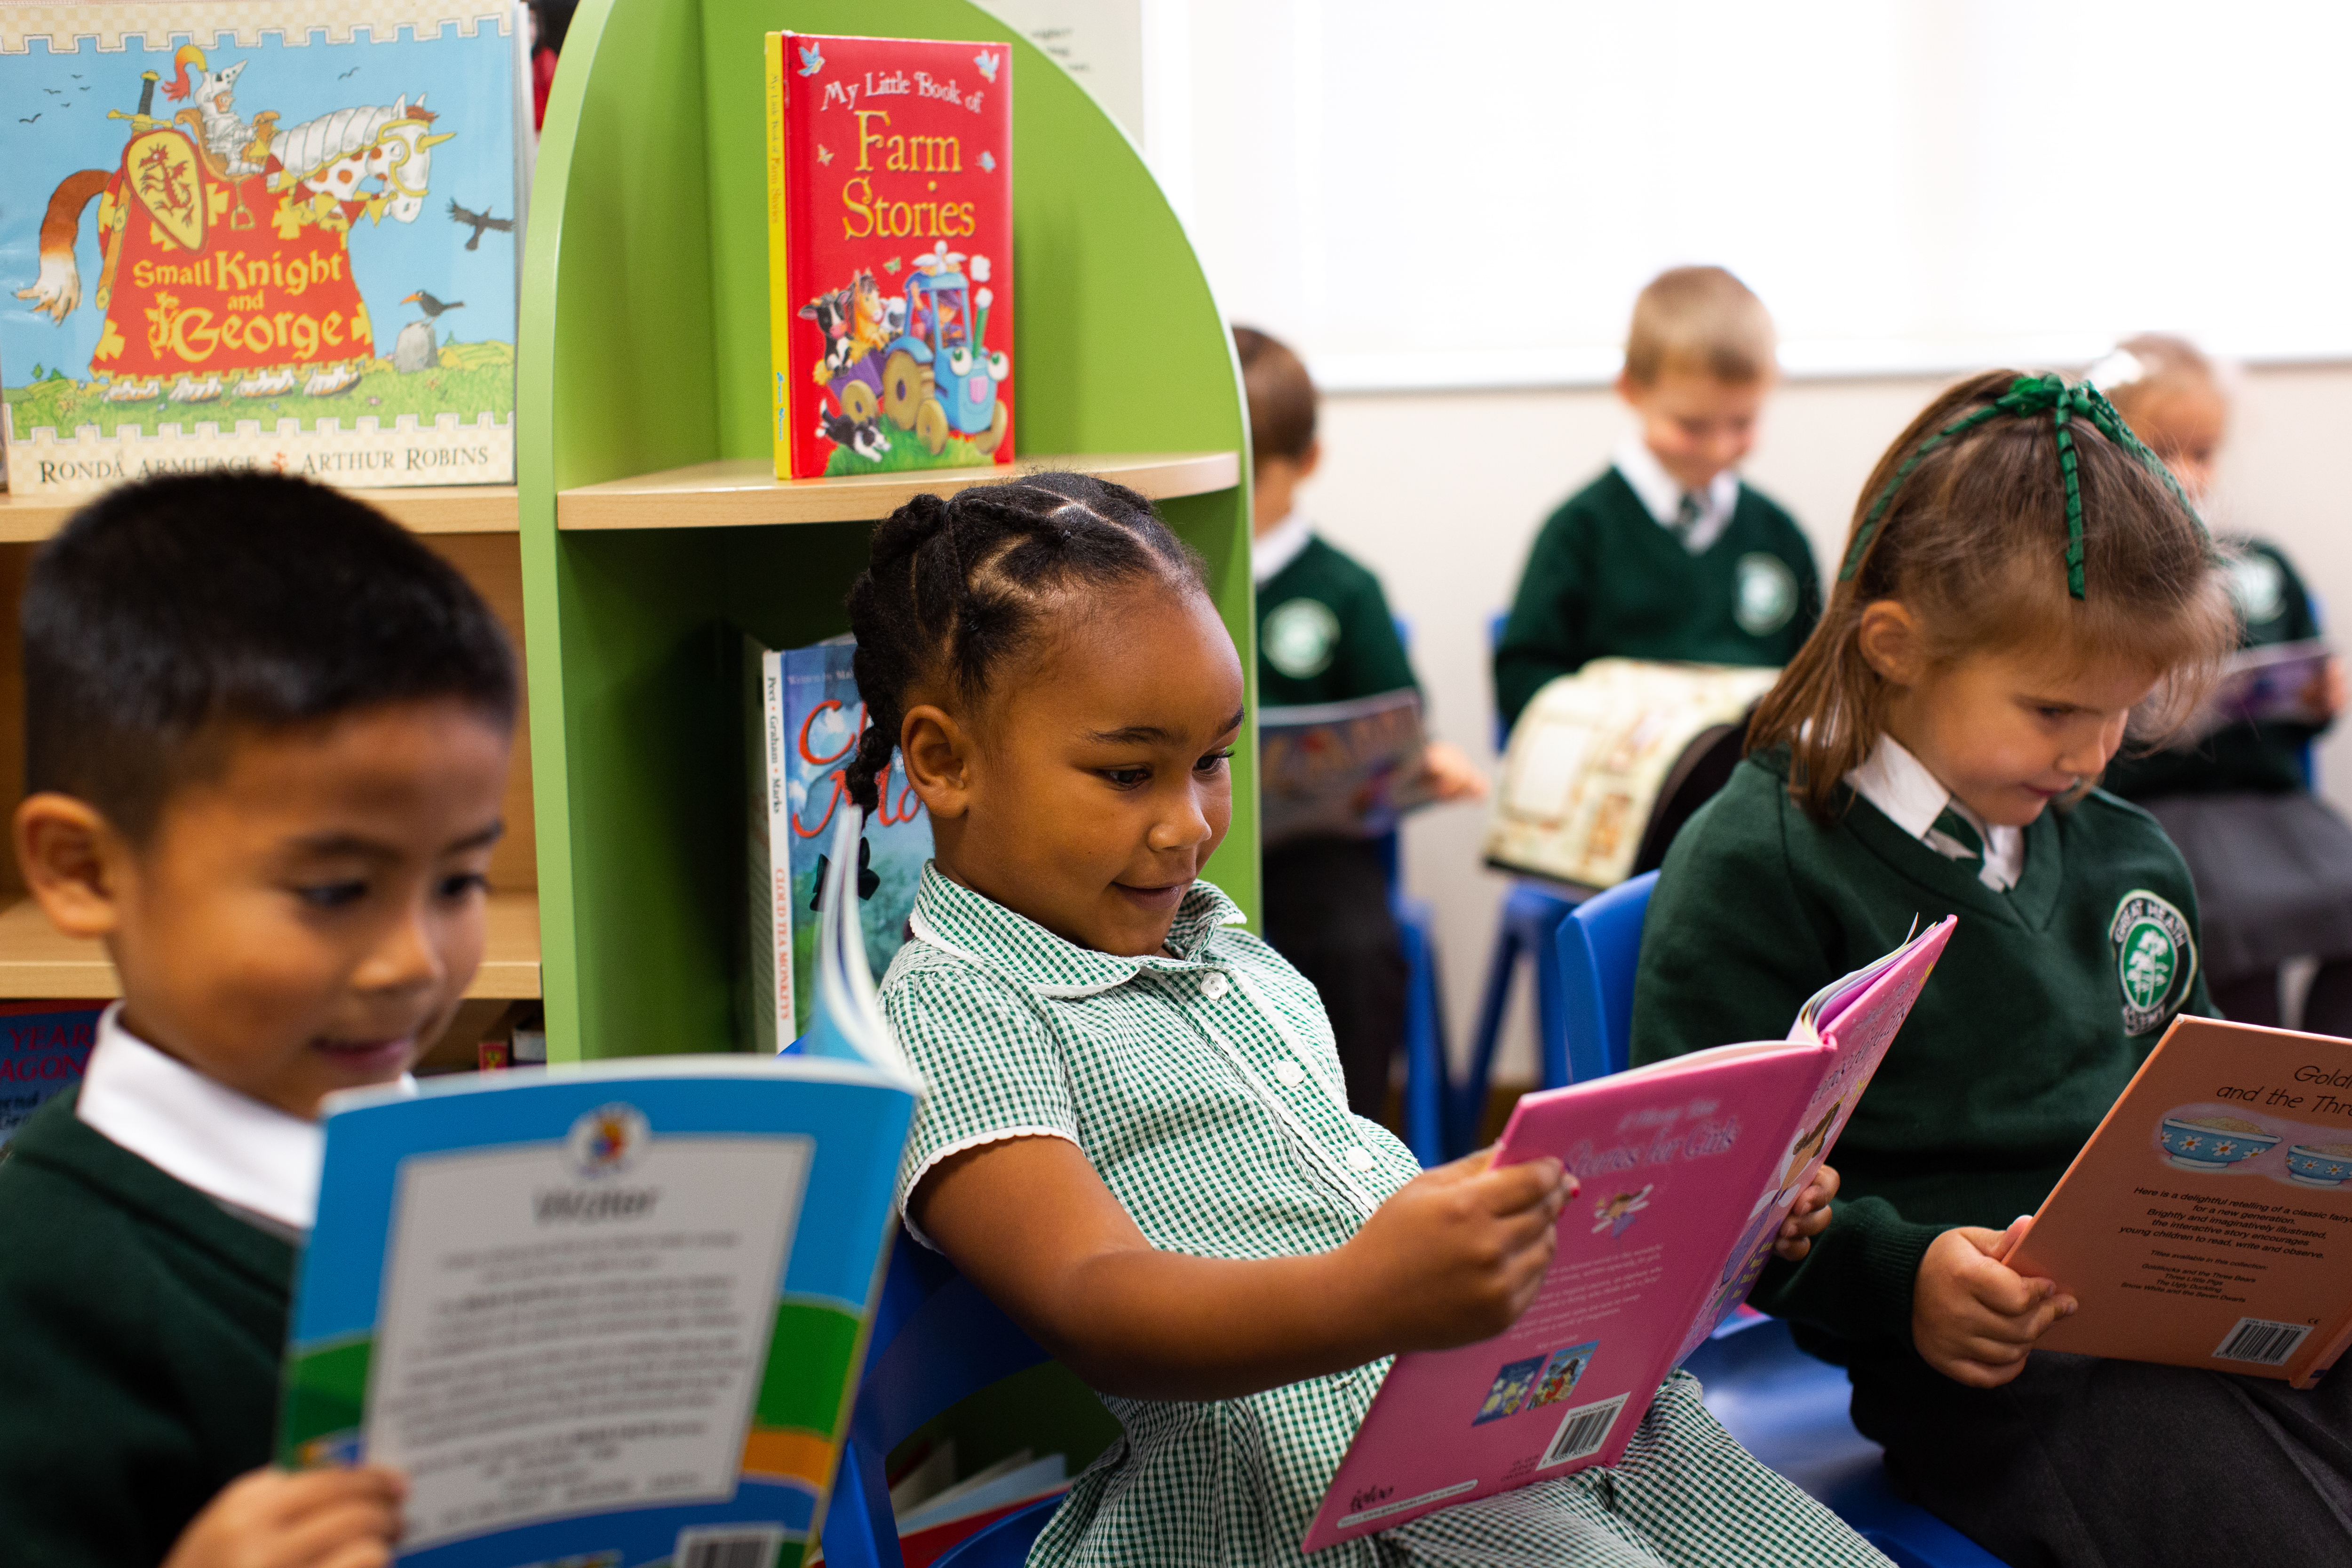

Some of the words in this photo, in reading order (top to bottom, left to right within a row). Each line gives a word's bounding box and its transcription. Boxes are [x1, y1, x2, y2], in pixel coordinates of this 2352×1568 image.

[821, 82, 859, 111] My
[865, 70, 910, 97] Little
[914, 72, 962, 105] Book
[965, 91, 984, 113] of
[855, 111, 962, 173] Farm
[842, 177, 975, 240] Stories
[133, 257, 211, 288] Small
[216, 249, 344, 295] Knight
[228, 290, 264, 311] and
[171, 307, 345, 362] George
[39, 459, 126, 485] RONDA
[137, 455, 257, 479] ARMITAGE
[302, 450, 394, 474] ARTHUR
[405, 446, 488, 471] ROBINS
[767, 676, 775, 701] Peet
[770, 716, 778, 764] Graham
[772, 778, 781, 814] Marks
[776, 868, 785, 917] CLOUD
[778, 921, 787, 947] TEA
[779, 952, 789, 1019] MONKEYS
[0, 1054, 88, 1082] AGON
[2295, 1066, 2352, 1090] Gold
[2217, 1086, 2265, 1101] and
[2266, 1089, 2304, 1108] the
[2134, 1187, 2158, 1196] Here
[2180, 1194, 2228, 1205] delightful
[2229, 1201, 2270, 1212] retelling
[2292, 1209, 2328, 1219] classic
[2240, 1212, 2295, 1224] generation.
[2146, 1209, 2186, 1221] Brightly
[2209, 1217, 2275, 1232] imaginatively
[2276, 1227, 2326, 1239] illustrated,
[2170, 1221, 2222, 1234] interactive
[2224, 1229, 2250, 1239] story
[2252, 1234, 2310, 1246] encourages
[2118, 1227, 2152, 1237] young
[2153, 1231, 2193, 1241] children
[2207, 1238, 2232, 1247] read,
[2236, 1241, 2260, 1250] write
[2283, 1248, 2324, 1259] observe.
[2142, 1264, 2181, 1274] Goldilocks
[2172, 1253, 2205, 1262] available
[2230, 1261, 2268, 1271] collection:
[2189, 1284, 2223, 1293] Duckling
